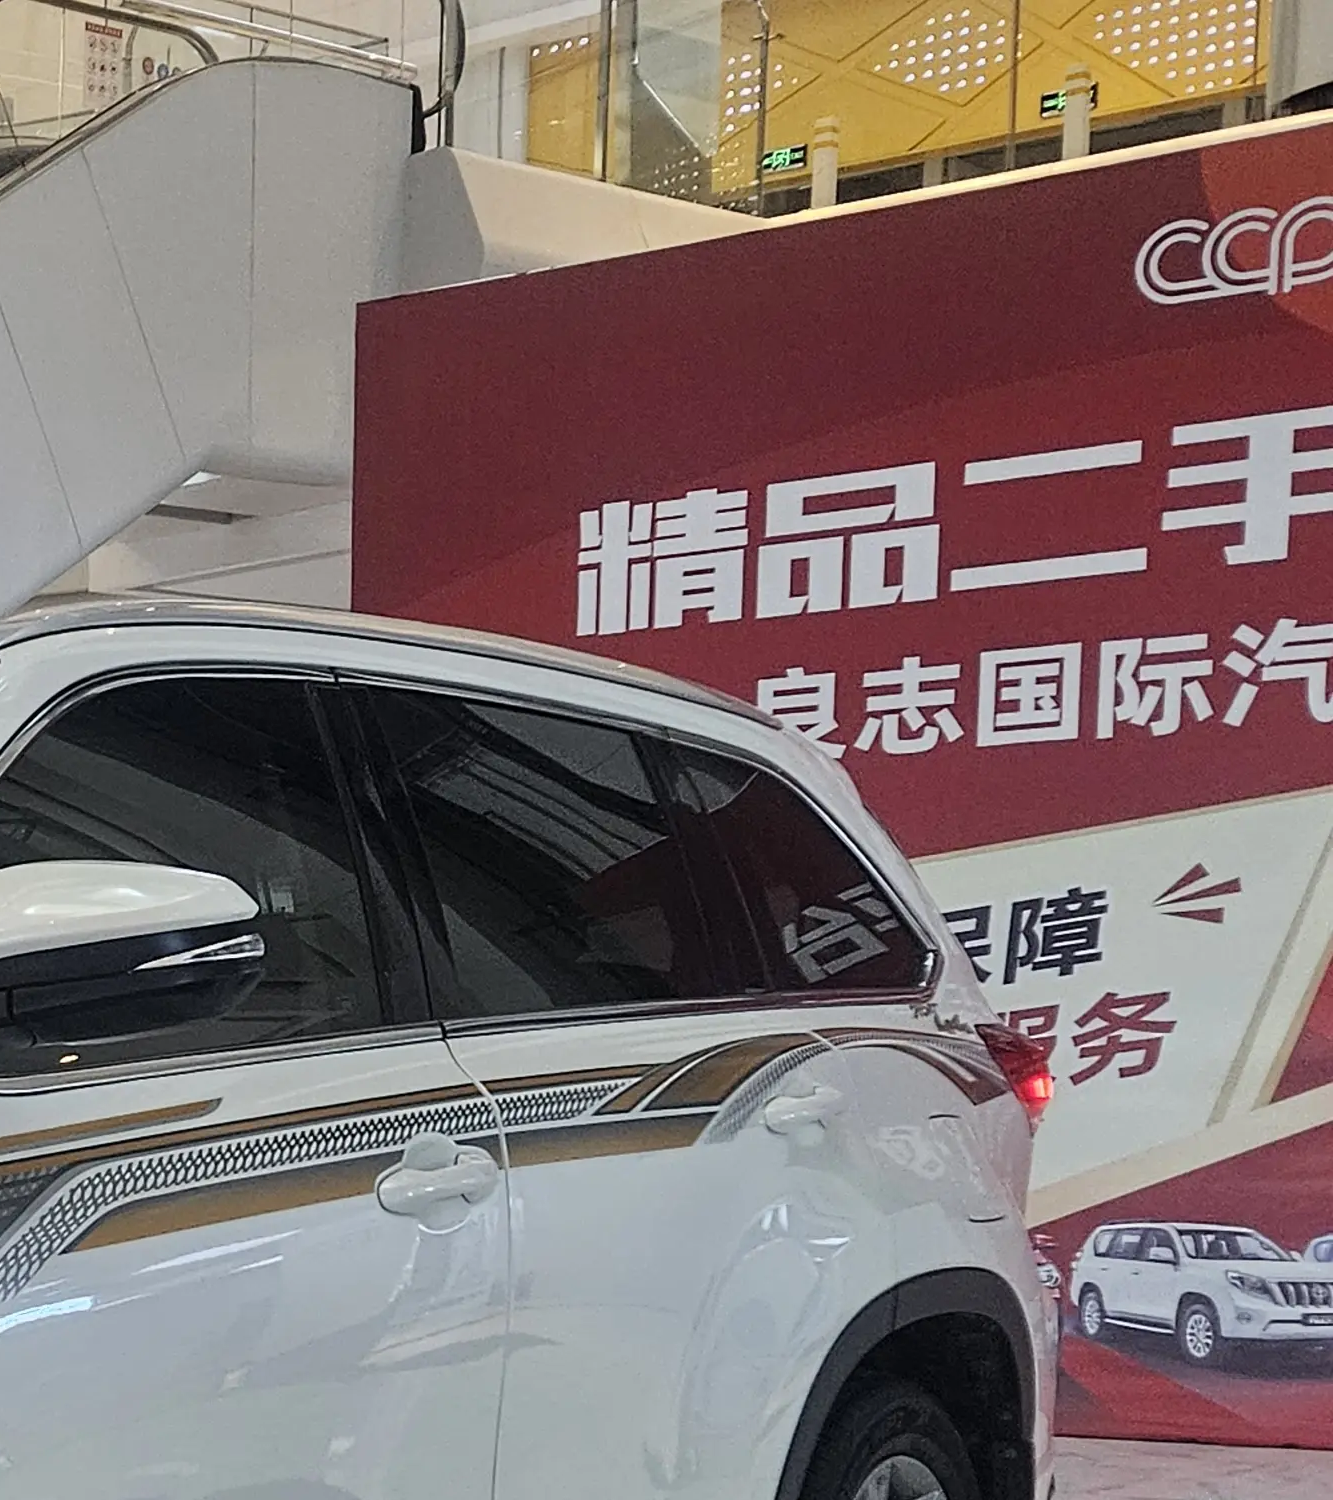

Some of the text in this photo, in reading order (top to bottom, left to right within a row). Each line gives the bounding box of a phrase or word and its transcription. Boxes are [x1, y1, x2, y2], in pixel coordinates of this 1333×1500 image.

[576, 405, 1333, 636] 精品二手
[756, 618, 1333, 759] 良志国际汽
